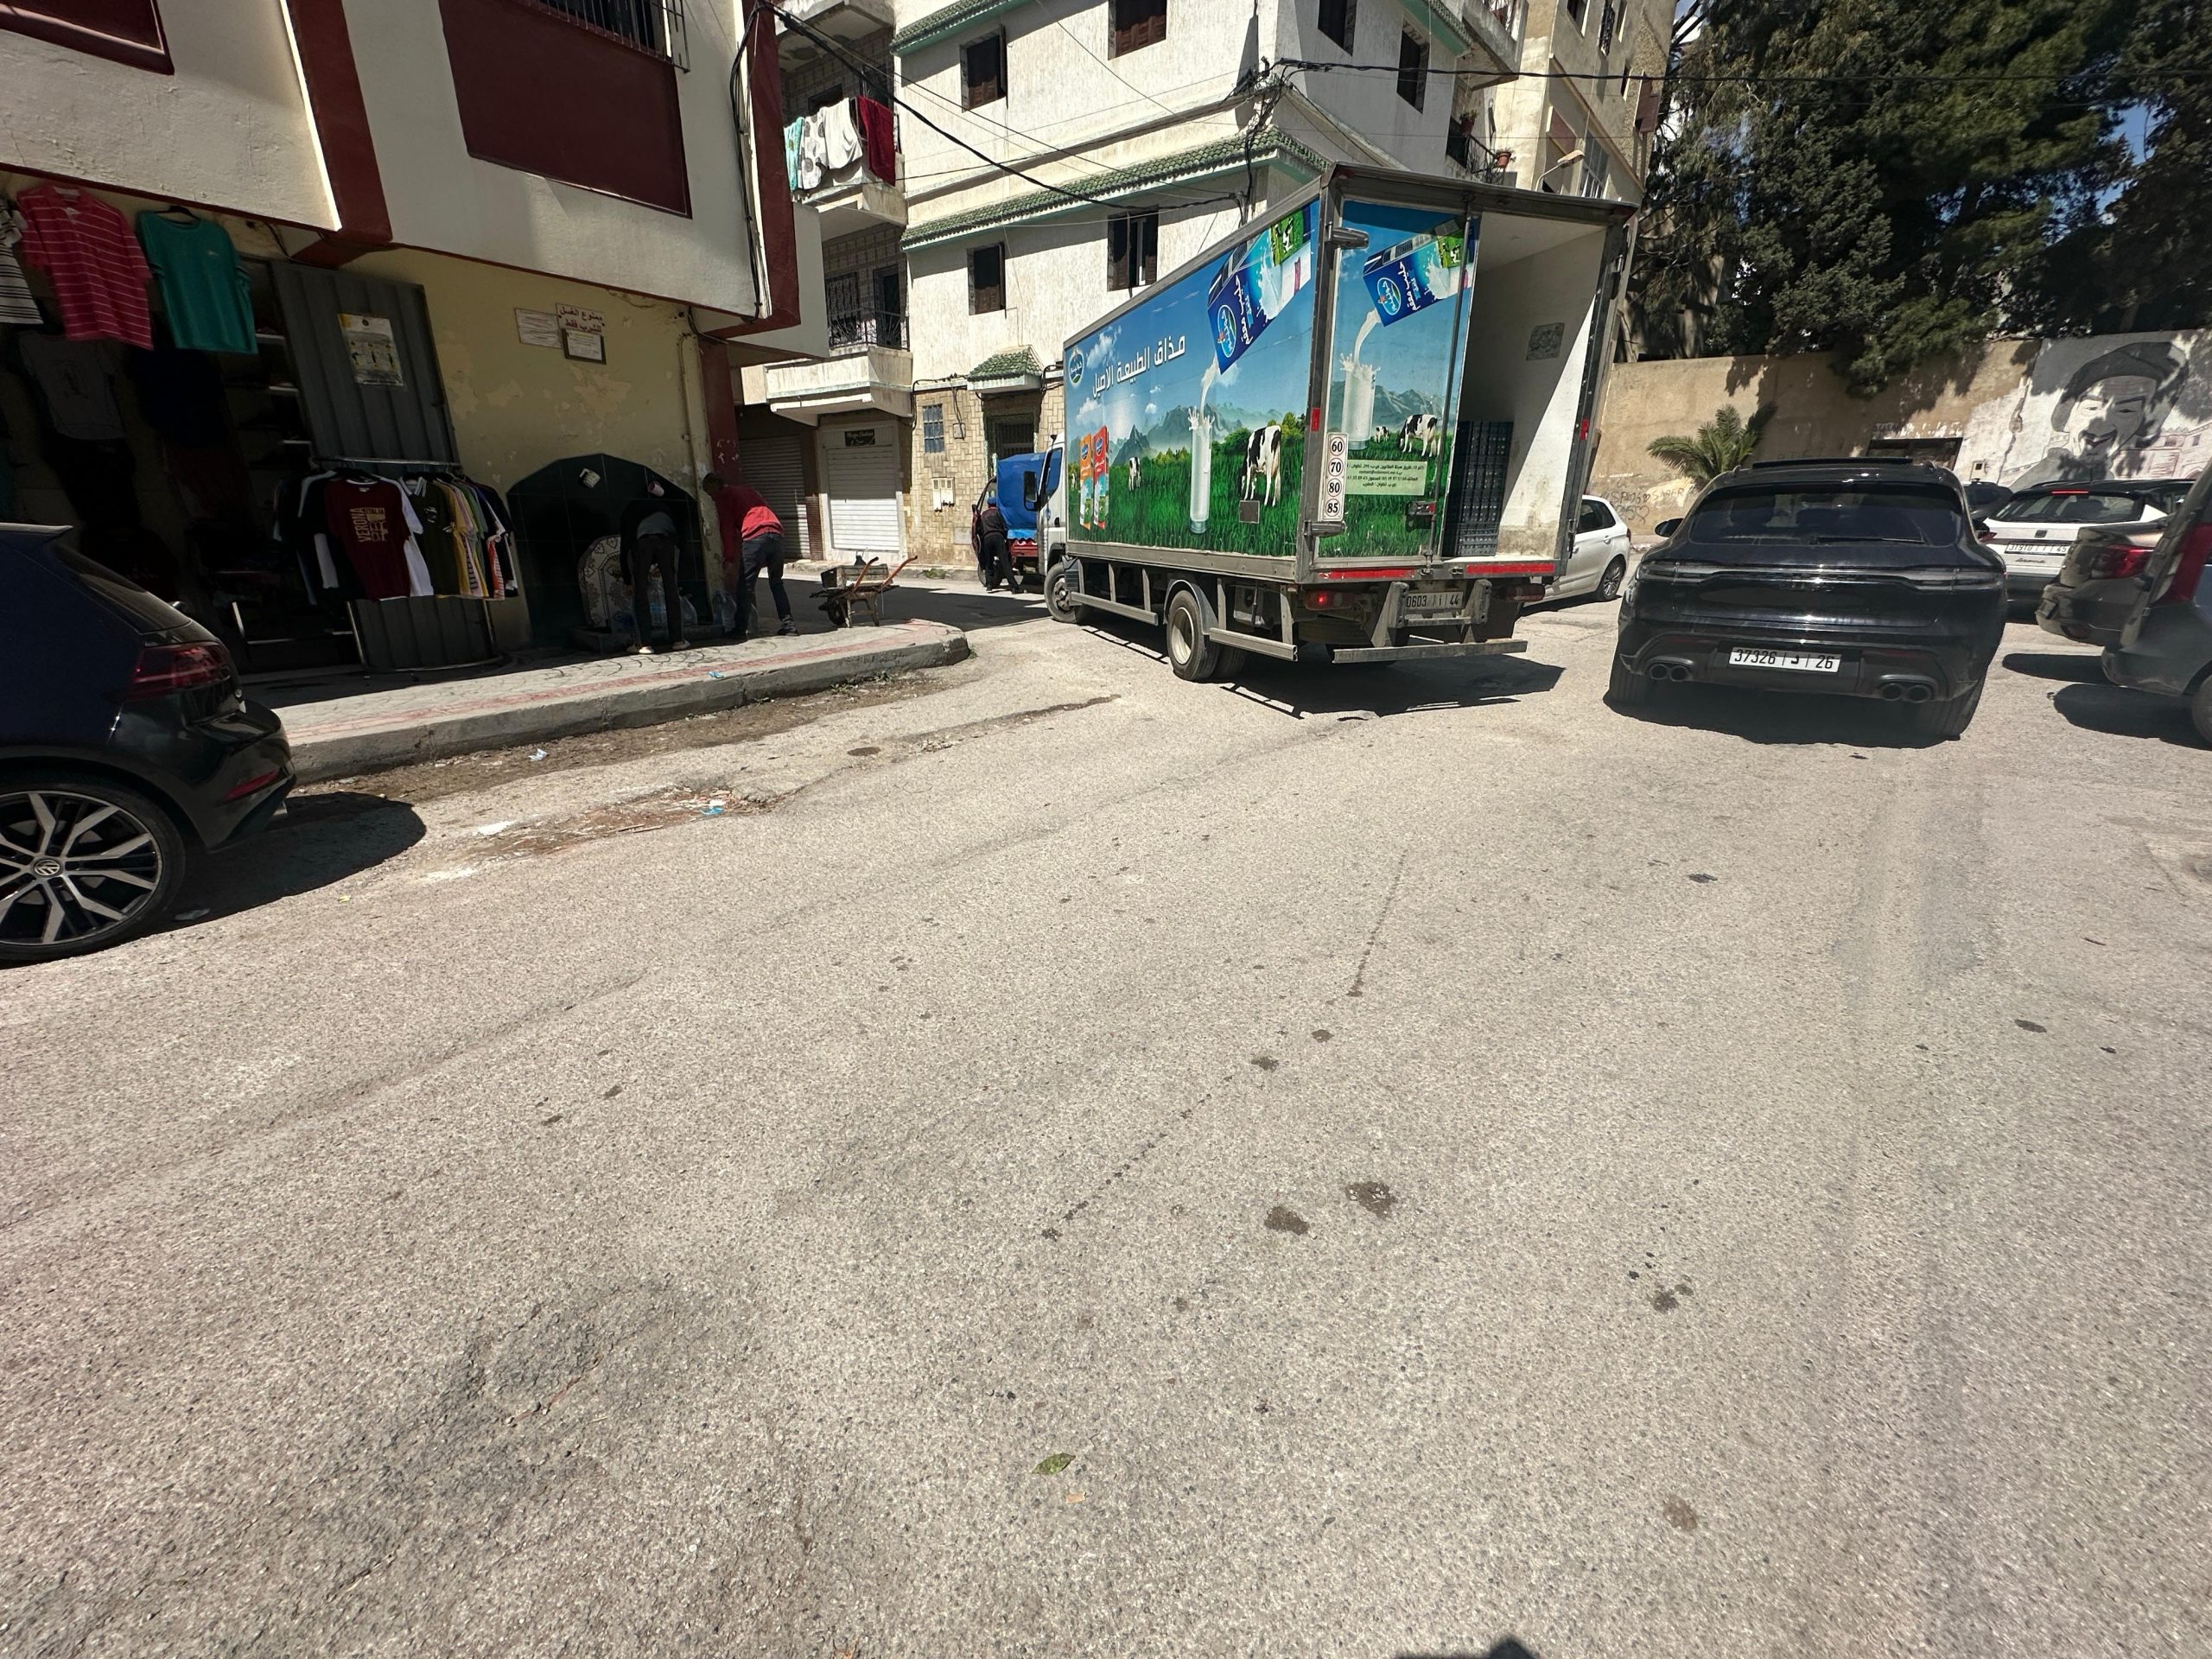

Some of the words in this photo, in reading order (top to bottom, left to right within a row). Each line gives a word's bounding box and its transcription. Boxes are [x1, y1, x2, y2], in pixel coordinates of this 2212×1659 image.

[1398, 261, 1410, 289] حليب
[1407, 290, 1421, 311] معقم
[581, 311, 603, 321] ممنوع
[1234, 275, 1244, 315] حليب
[1241, 317, 1254, 345] معقم
[565, 318, 579, 328] فقط
[1154, 334, 1185, 366] مذاق
[1116, 346, 1150, 385] الطبيعة
[1092, 362, 1114, 398] الأصيل
[1332, 441, 1343, 452] 60
[1331, 461, 1342, 473] 70
[1329, 482, 1340, 493] 80
[1326, 502, 1338, 513] 85
[349, 507, 372, 543] VERONA
[1450, 594, 1459, 606] 44
[1734, 649, 1777, 664] 37326
[1815, 654, 1835, 670] 26
